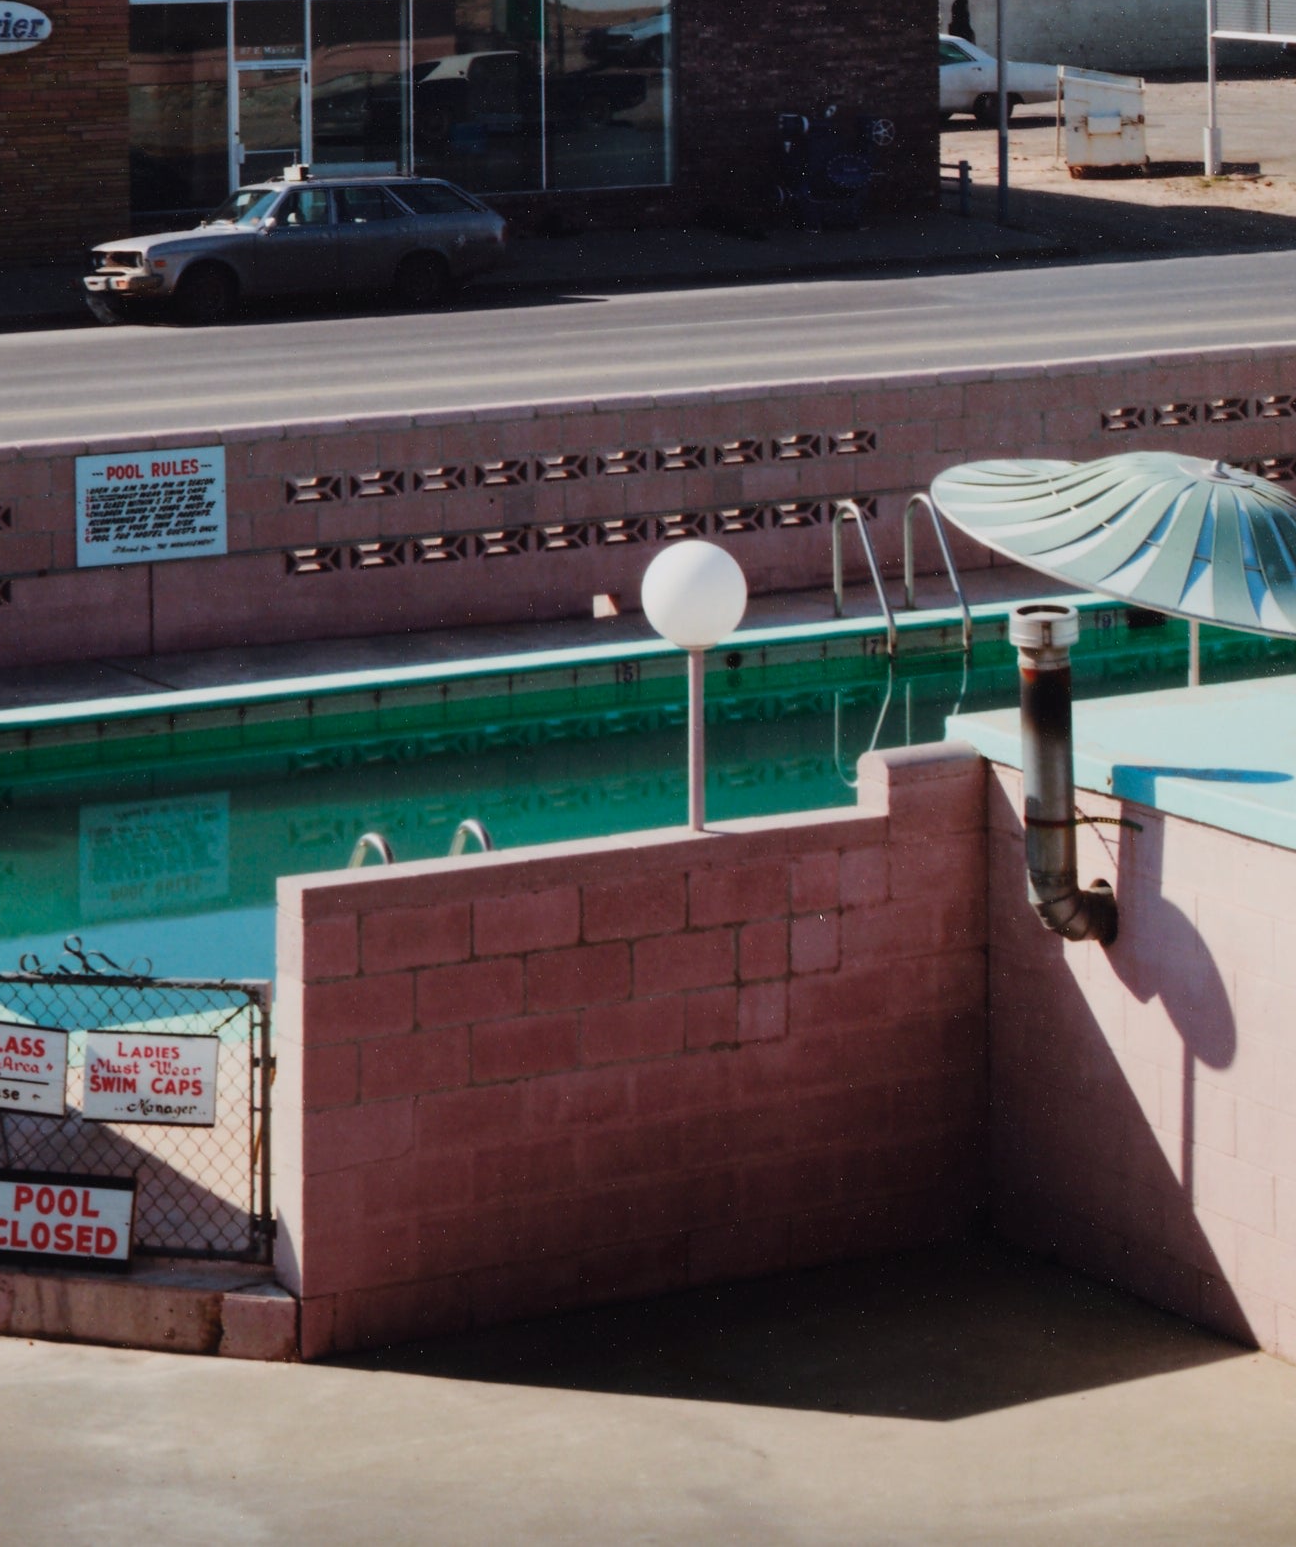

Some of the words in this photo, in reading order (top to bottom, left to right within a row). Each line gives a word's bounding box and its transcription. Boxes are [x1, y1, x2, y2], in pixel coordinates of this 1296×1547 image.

[106, 464, 144, 481] POOL
[151, 458, 200, 477] RULES
[117, 1041, 181, 1060] LADIES
[90, 1056, 141, 1075] Must
[149, 1060, 203, 1077] Wear
[89, 1074, 137, 1095] SWIM
[151, 1077, 203, 1097] CAPS
[13, 1184, 100, 1219] POOL
